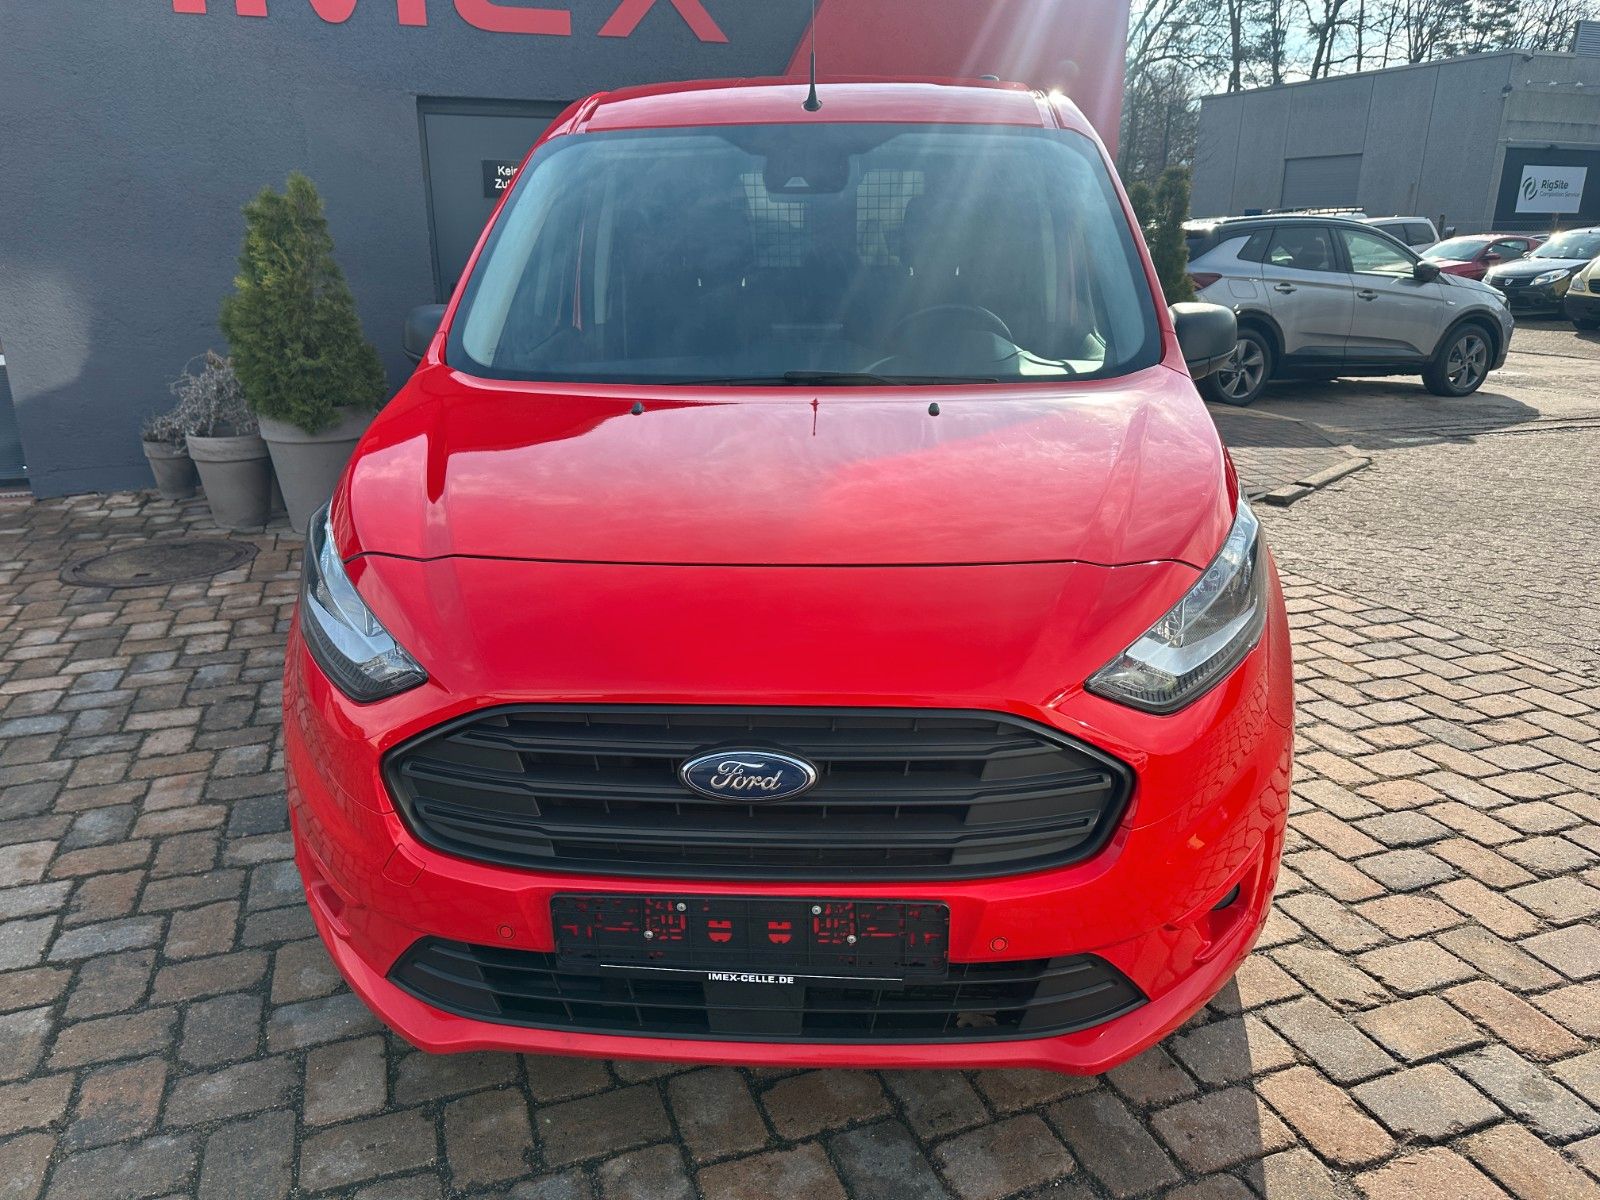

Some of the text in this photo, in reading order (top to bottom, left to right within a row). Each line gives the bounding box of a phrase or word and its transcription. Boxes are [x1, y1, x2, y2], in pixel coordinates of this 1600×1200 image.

[1541, 179, 1569, 191] RigSite
[710, 760, 784, 790] Ford
[708, 973, 794, 984] IMEX-CELLE.DE
